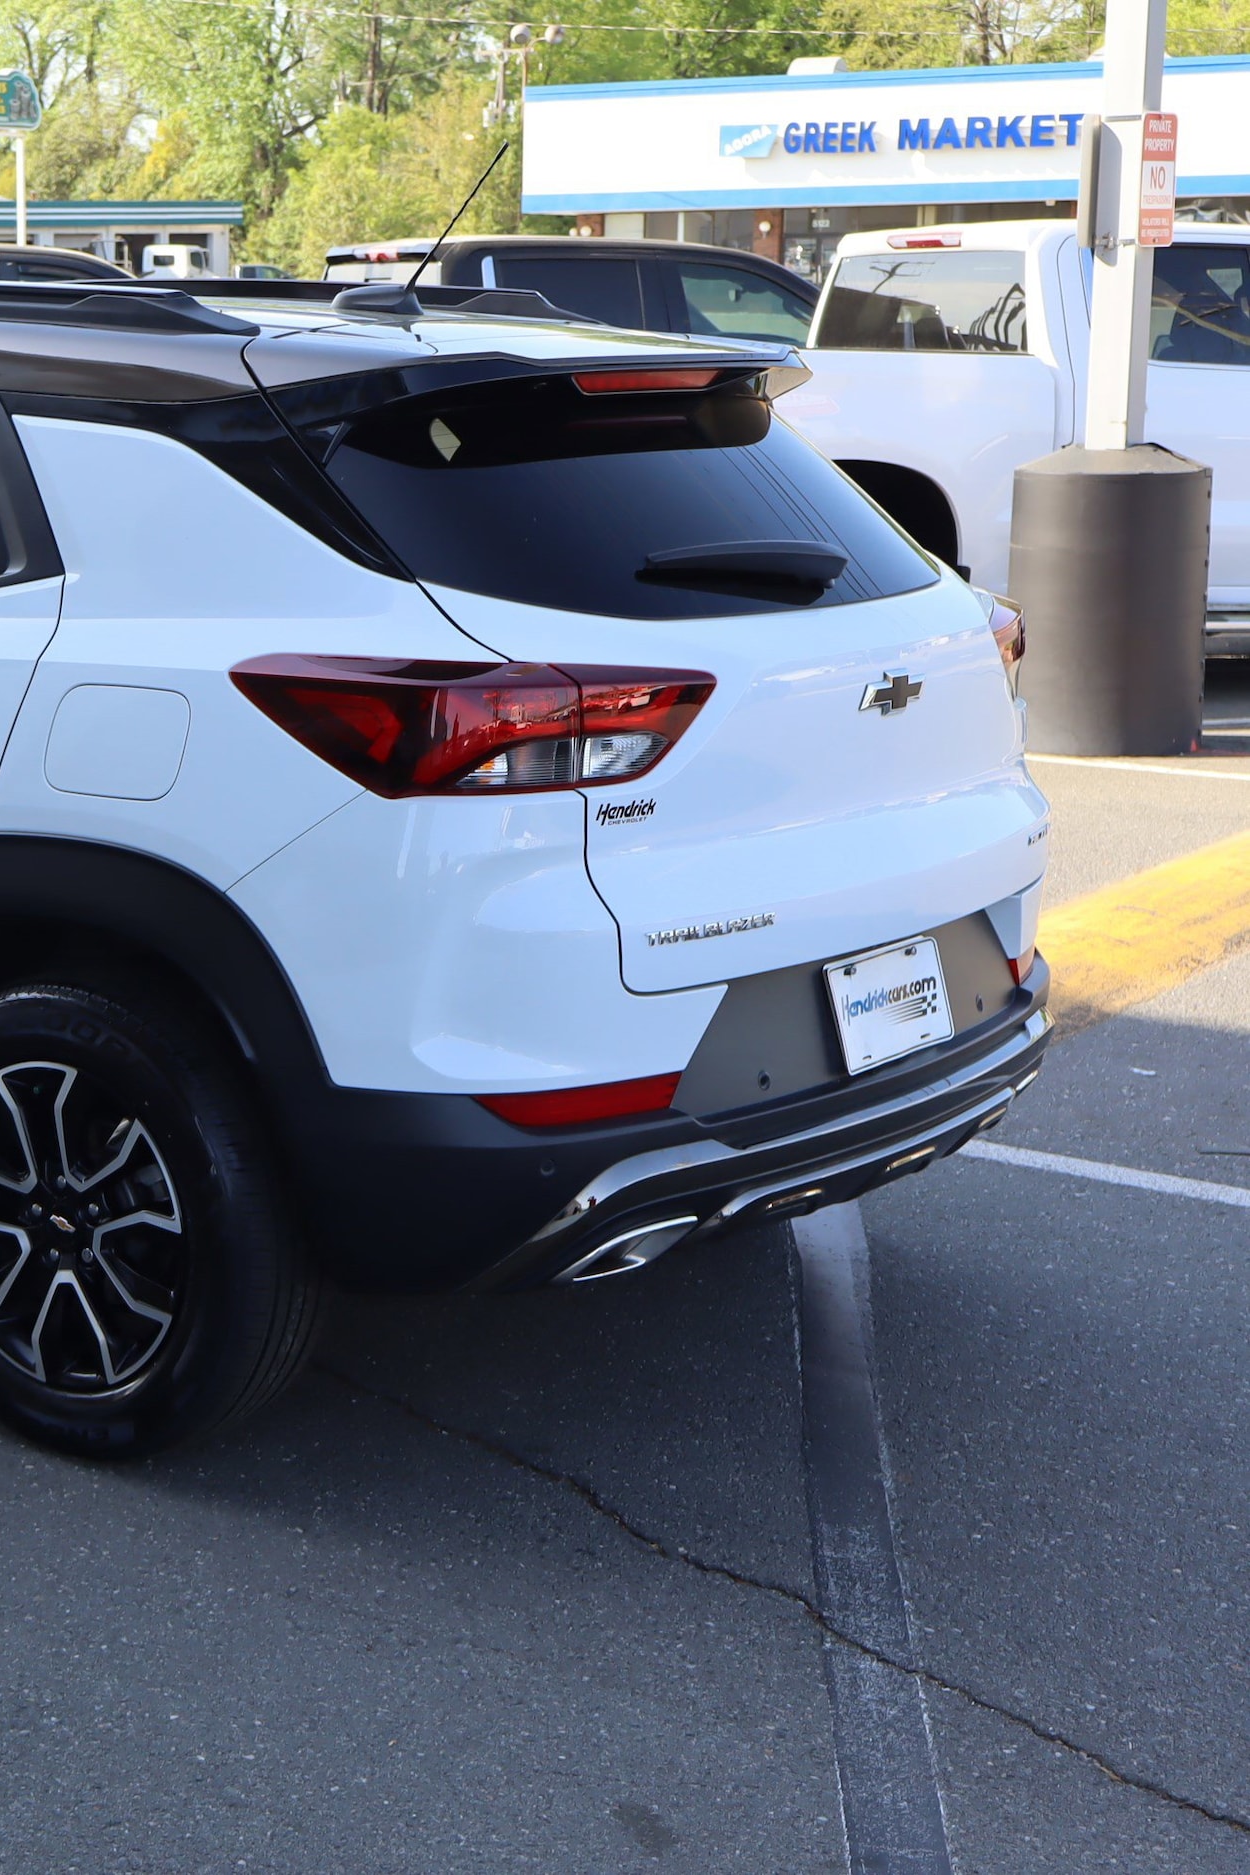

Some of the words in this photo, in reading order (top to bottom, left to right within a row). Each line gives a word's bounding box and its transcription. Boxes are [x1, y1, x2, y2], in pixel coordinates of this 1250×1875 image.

[724, 124, 773, 156] AGORA
[783, 121, 877, 154] GREEK
[897, 113, 1084, 151] MARKET
[1149, 119, 1172, 134] PRIVATE
[1144, 138, 1175, 152] PROPERTY
[1150, 166, 1166, 190] NO
[595, 798, 657, 827] Hendrick
[607, 816, 647, 826] CHEVROLET
[645, 912, 776, 947] TRAILBLAZER
[841, 976, 937, 1027] Hendrickcars.com
